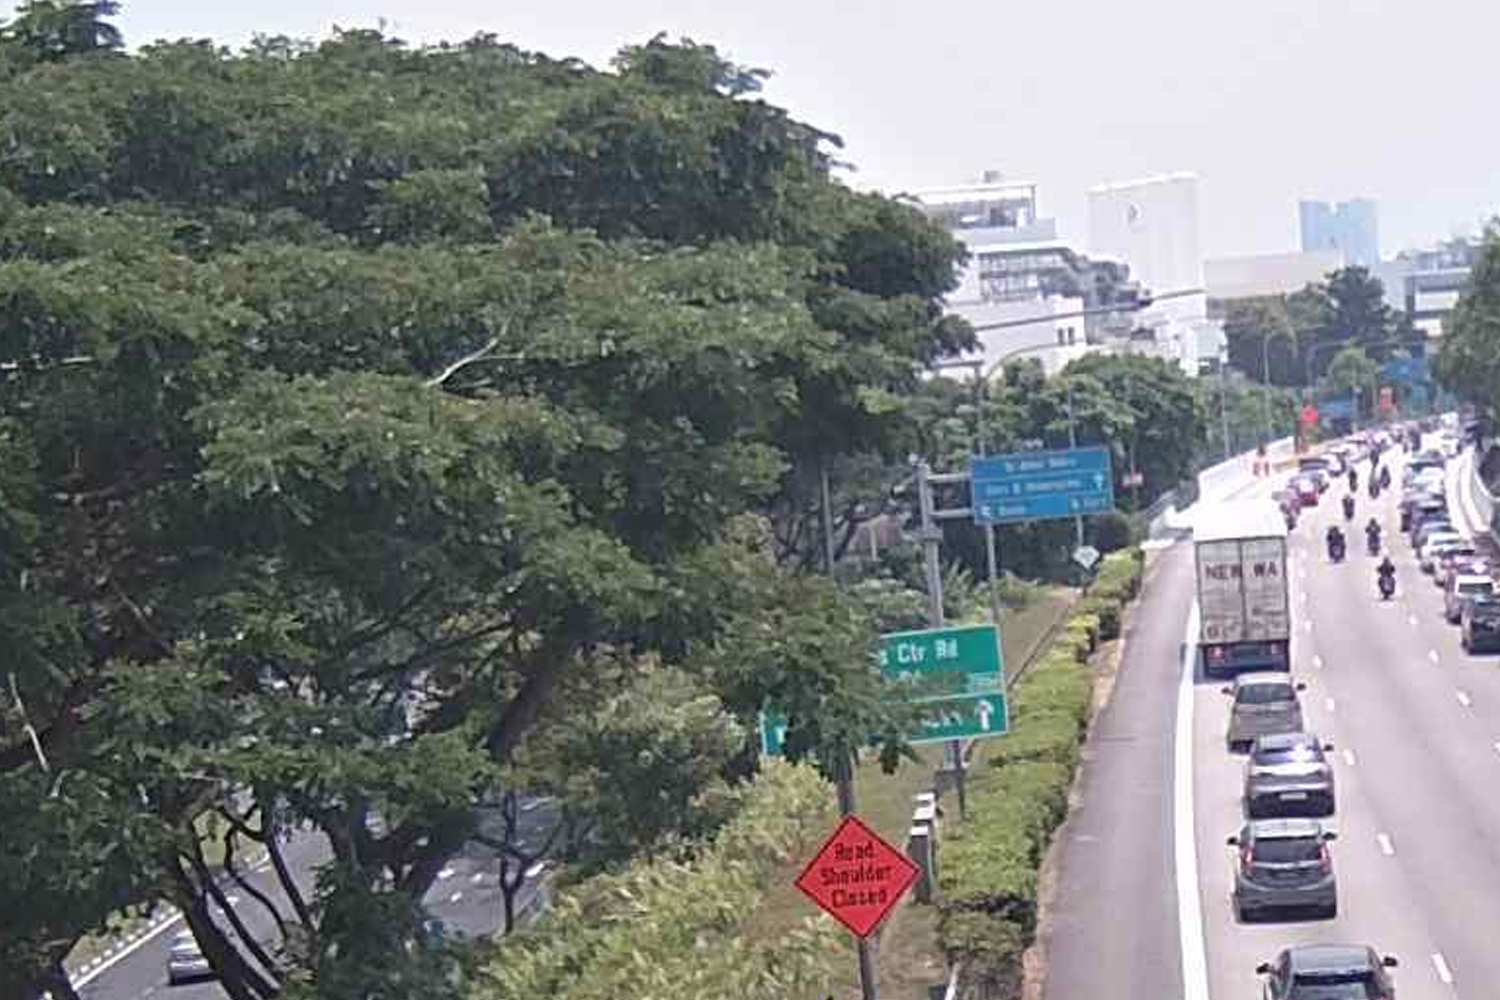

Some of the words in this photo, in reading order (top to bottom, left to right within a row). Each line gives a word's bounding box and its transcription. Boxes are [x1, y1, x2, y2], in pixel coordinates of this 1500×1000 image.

[898, 643, 926, 663] Ctr
[935, 639, 958, 658] Rd
[834, 841, 874, 860] Road
[821, 864, 892, 886] Shoulder
[832, 888, 887, 908] Closed
